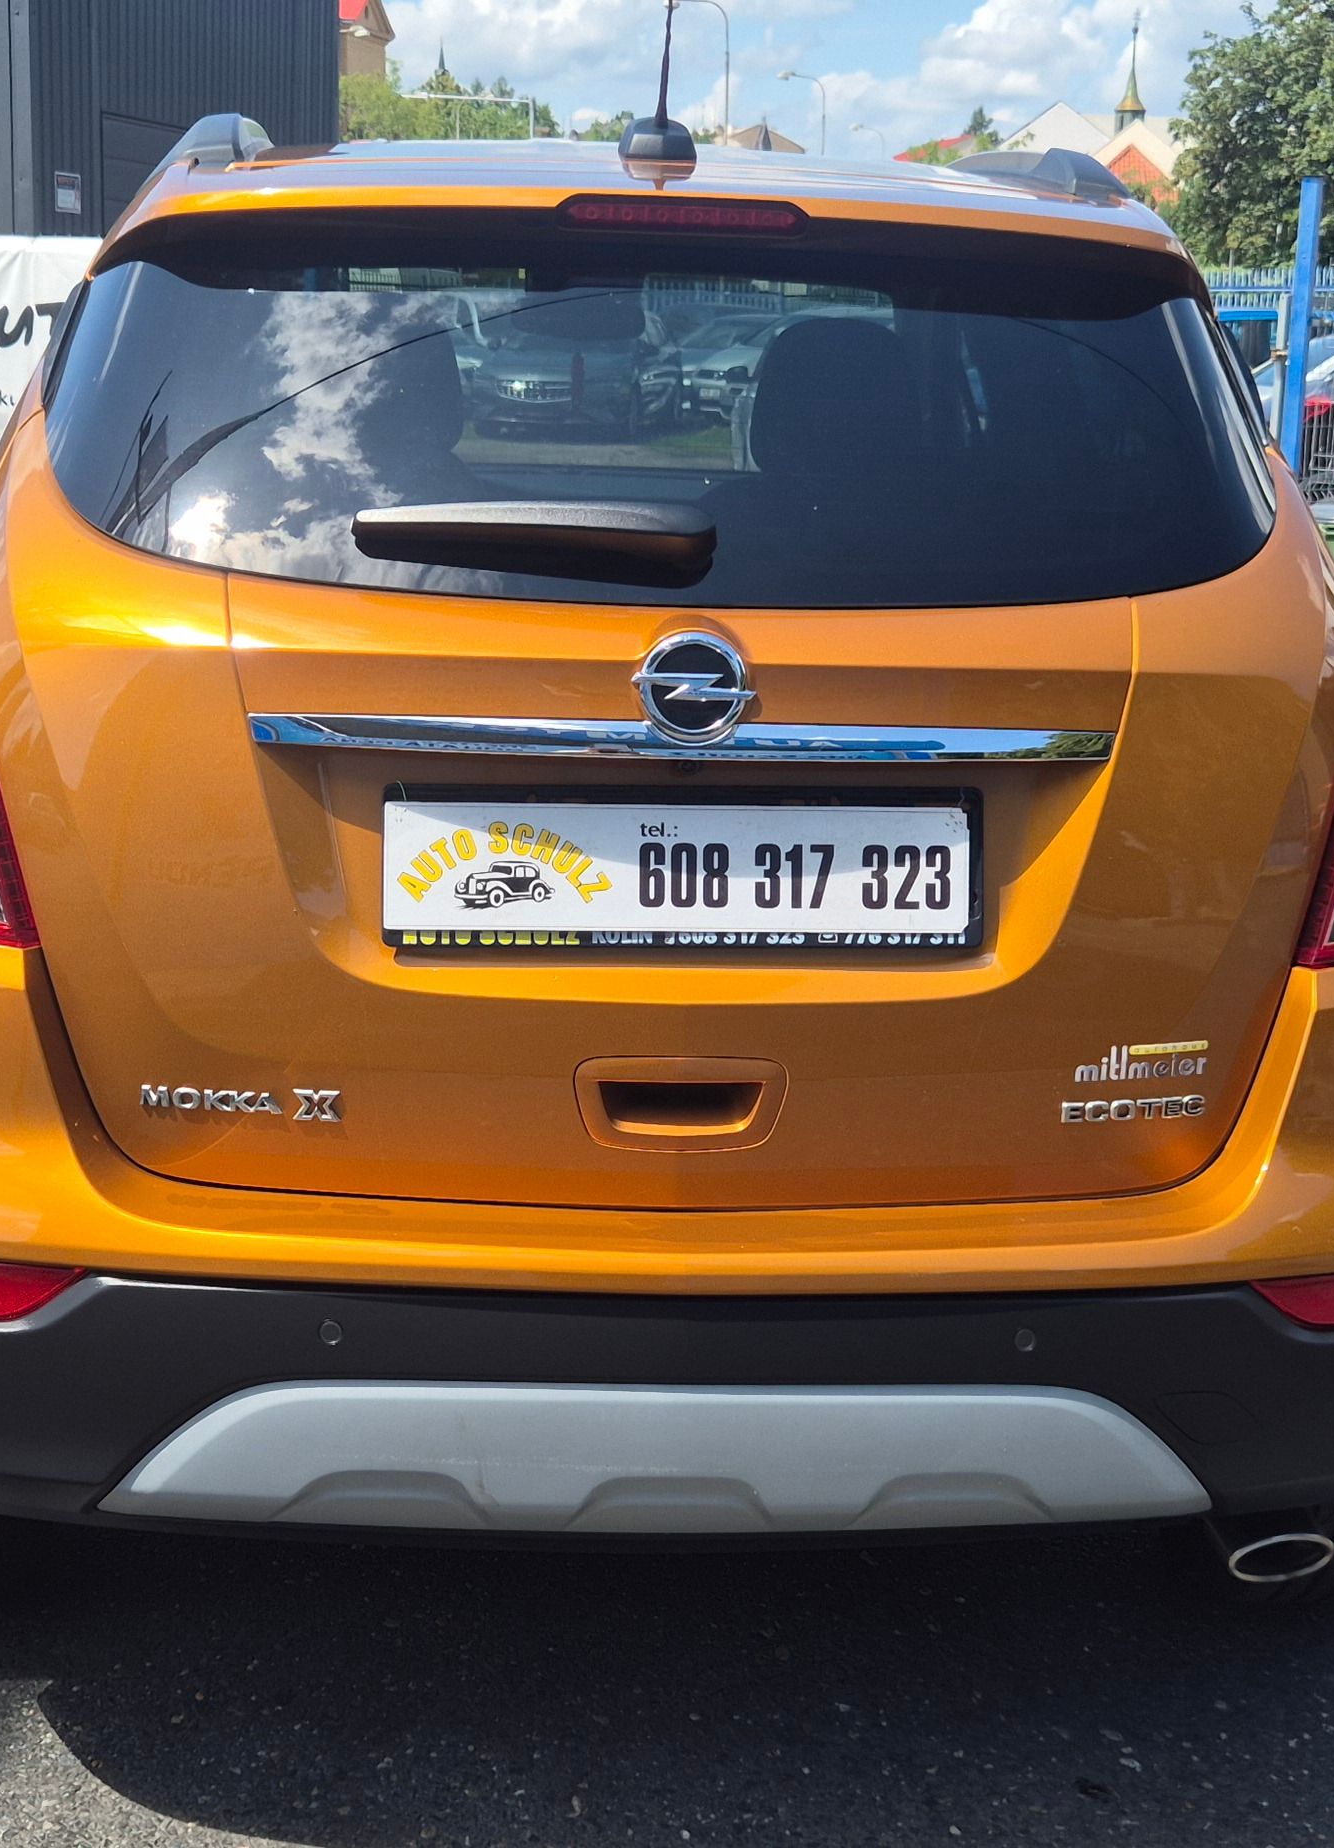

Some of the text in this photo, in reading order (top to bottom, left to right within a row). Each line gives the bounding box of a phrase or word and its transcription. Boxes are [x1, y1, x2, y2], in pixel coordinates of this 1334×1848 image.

[639, 822, 678, 837] tel.:
[397, 821, 613, 904] AUTO SCHULZ
[639, 842, 951, 910] 608 317 323
[140, 1084, 342, 1122] MOKKA X
[1061, 1094, 1205, 1123] ECOTEC
